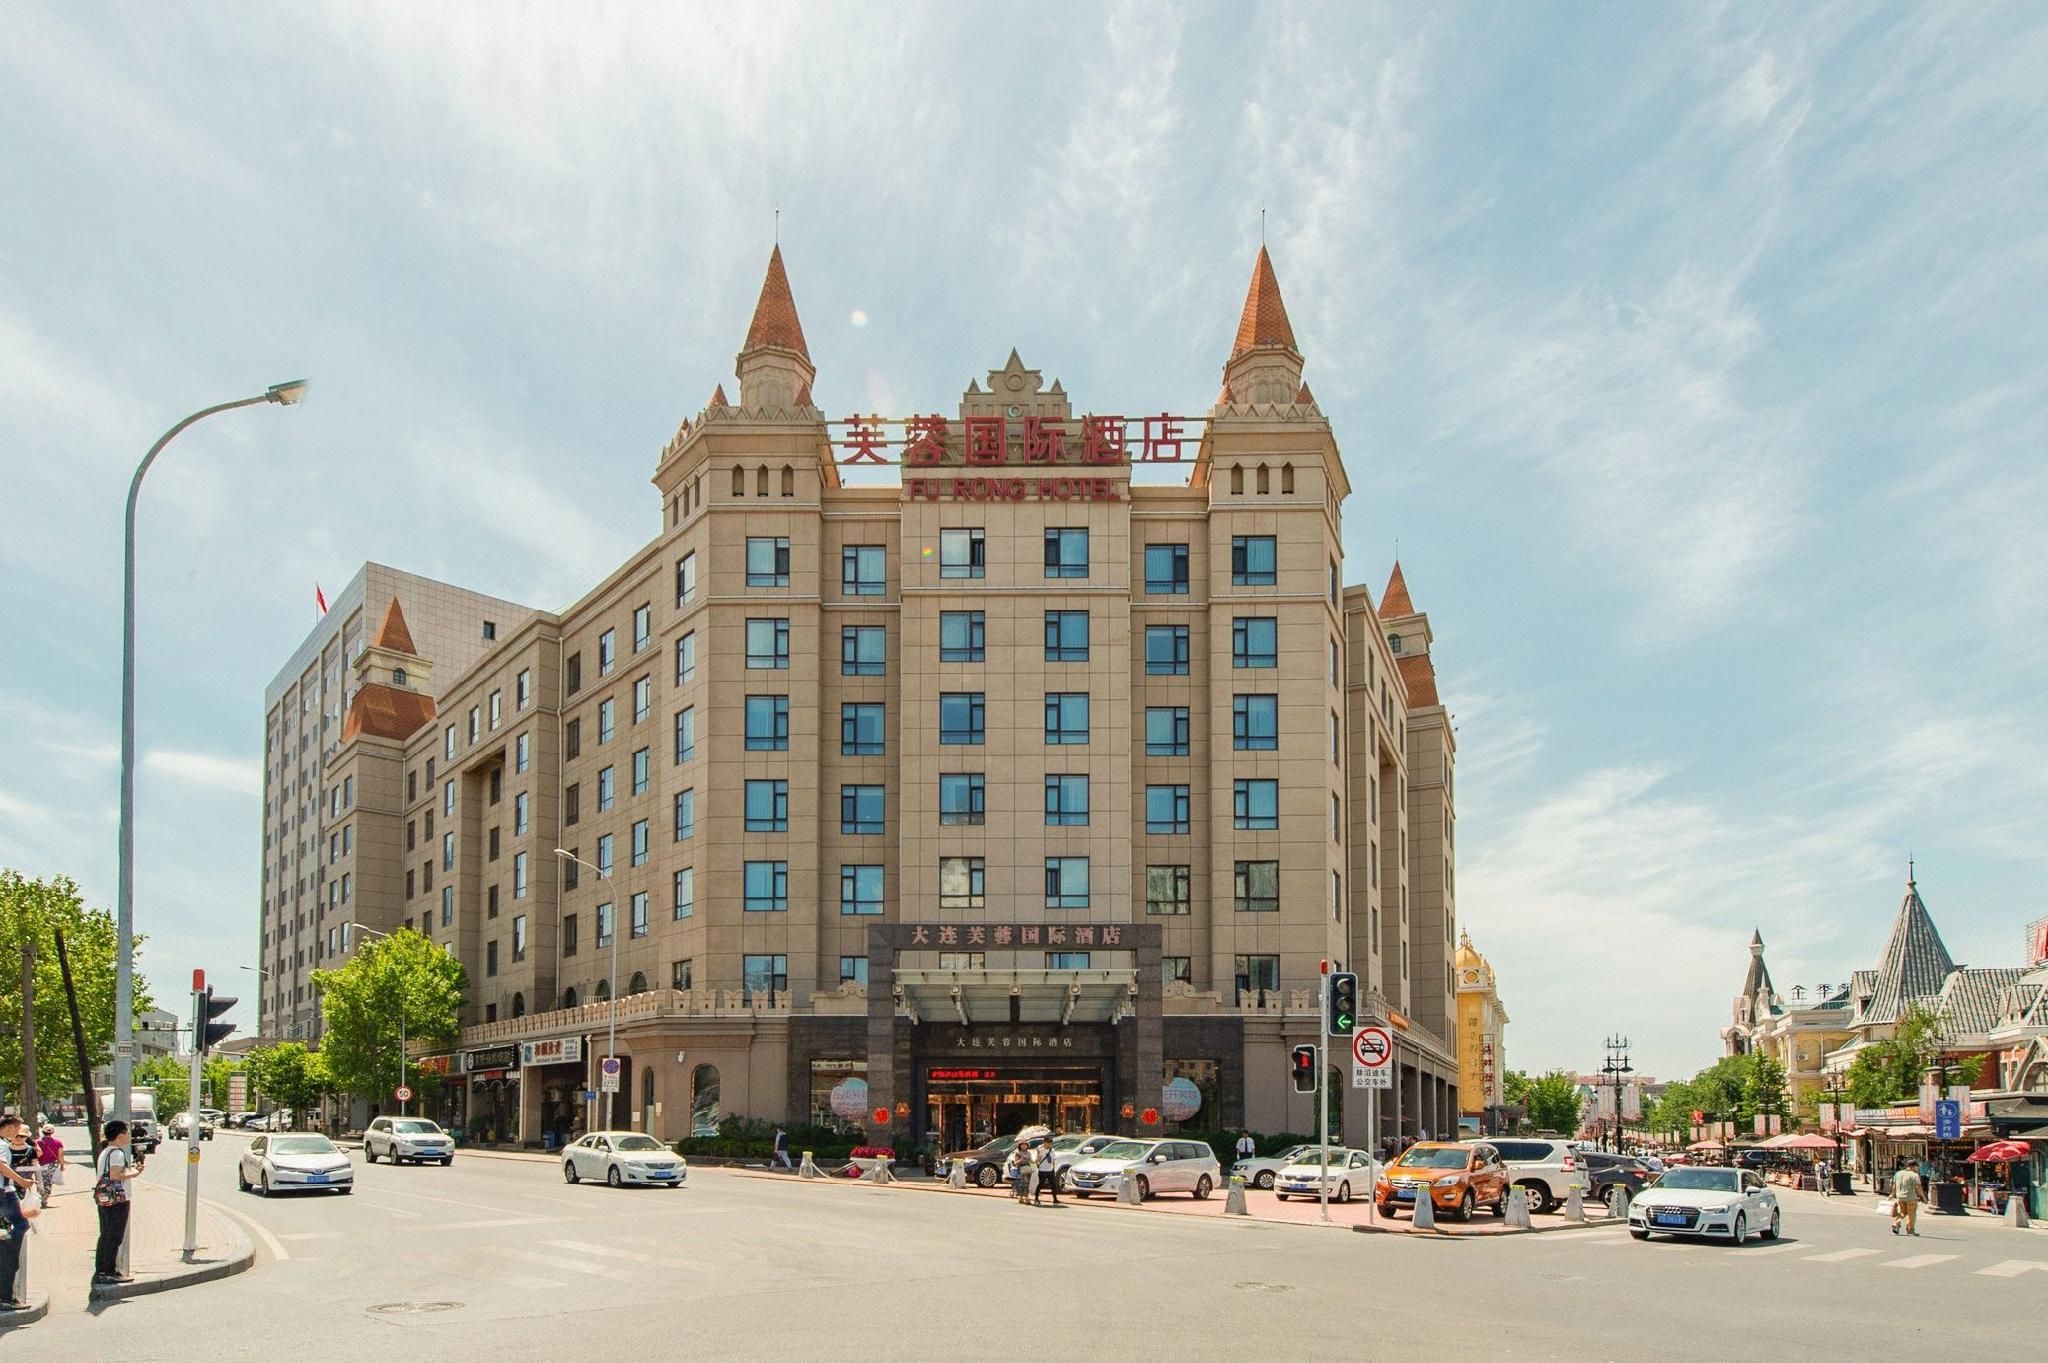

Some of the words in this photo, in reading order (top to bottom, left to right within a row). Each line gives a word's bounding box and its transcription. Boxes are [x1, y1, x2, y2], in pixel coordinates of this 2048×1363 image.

[843, 413, 1185, 465] 芙蓉国际酒店
[909, 477, 941, 500] FU
[952, 476, 1026, 501] RONG
[1038, 476, 1121, 501] HOTEL
[911, 926, 1121, 945] 大连芙蓉国际酒店
[957, 1037, 1073, 1048] 大连芙蓉国际酒店
